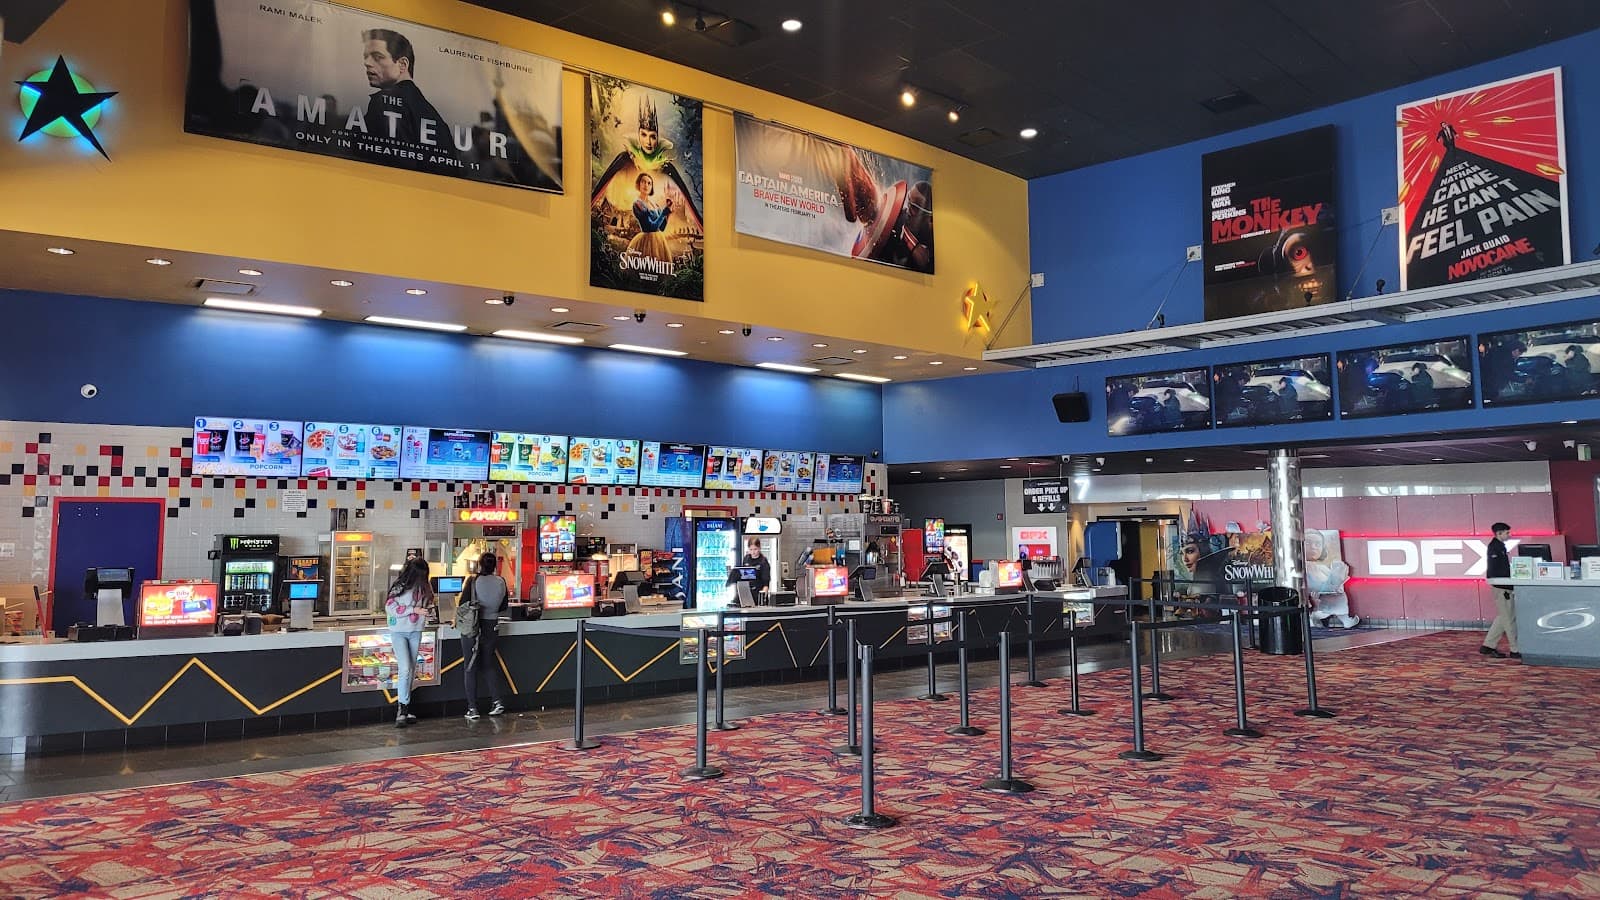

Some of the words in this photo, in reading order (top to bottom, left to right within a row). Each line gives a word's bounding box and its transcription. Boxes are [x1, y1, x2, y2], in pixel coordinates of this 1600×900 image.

[260, 4, 286, 16] RAMI
[289, 11, 323, 24] MALEK
[439, 47, 485, 62] LAURENCE
[487, 57, 533, 73] FISHBURNE
[382, 95, 402, 107] THE
[251, 87, 507, 159] AMATEUR
[295, 131, 331, 144] ONLY
[338, 139, 351, 148] IN
[357, 142, 423, 160] THEATERS
[429, 155, 464, 168] APRIL
[332, 129, 357, 138] DON'T
[362, 135, 429, 151] UNDERESTIMATE
[1440, 164, 1481, 187] NATHAN
[1445, 161, 1469, 176] MEET
[738, 170, 787, 193] CAPTAIN
[789, 185, 838, 207] AMERICA
[1432, 169, 1499, 205] CAINE
[753, 188, 779, 202] BRAVE
[780, 196, 797, 207] NEW
[799, 200, 825, 214] WORLD
[1250, 196, 1281, 213] THE
[1421, 203, 1448, 229] HE
[1453, 178, 1519, 215] CAN'T
[1211, 202, 1322, 242] MONKEY
[1406, 219, 1474, 265] FEEL
[1477, 188, 1560, 235] PAIN
[1448, 237, 1535, 280] NOVOCAINE
[1460, 244, 1482, 259] JACK
[1482, 234, 1510, 251] QUAID
[1024, 487, 1044, 495] ORDER
[1074, 477, 1090, 500] 7
[470, 510, 508, 521] POPCORN
[1020, 531, 1048, 539] DFX
[1367, 539, 1521, 576] DFX
